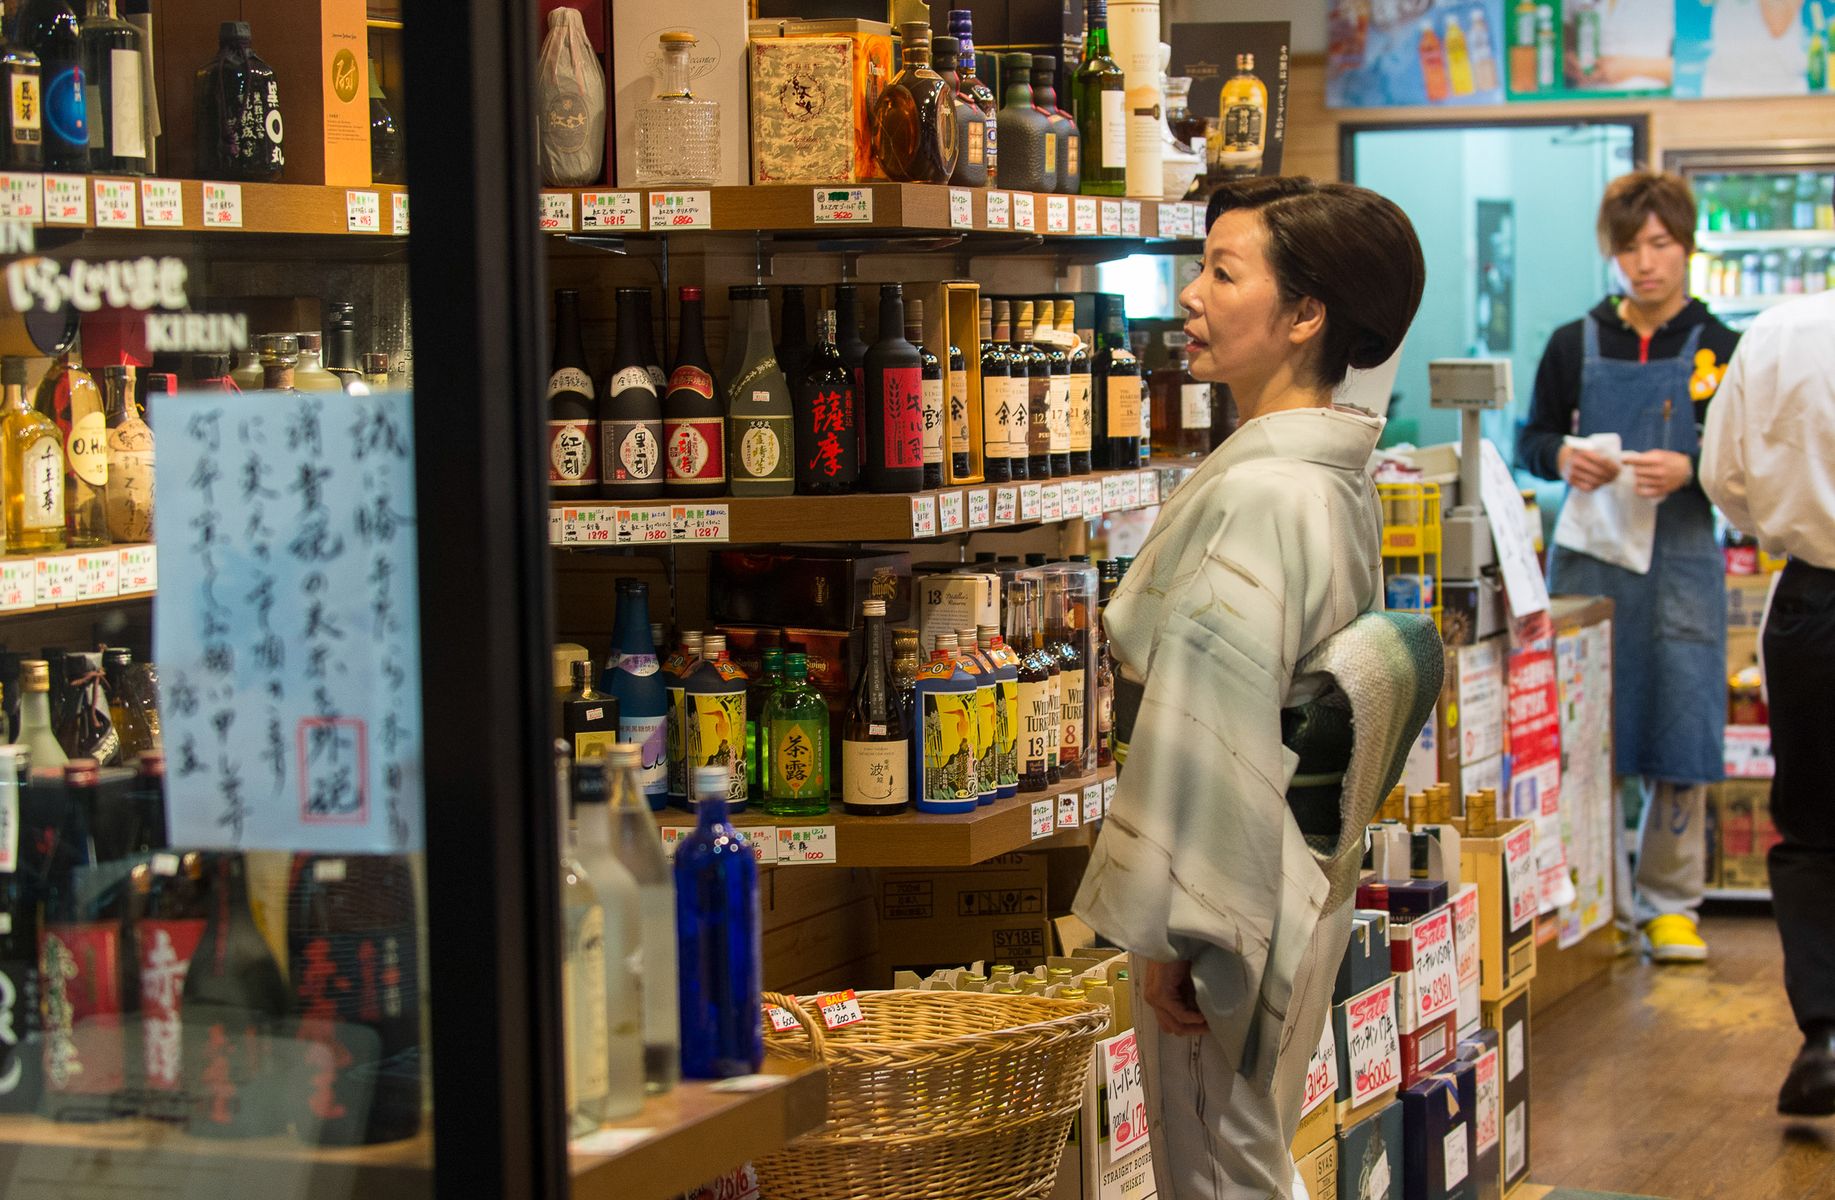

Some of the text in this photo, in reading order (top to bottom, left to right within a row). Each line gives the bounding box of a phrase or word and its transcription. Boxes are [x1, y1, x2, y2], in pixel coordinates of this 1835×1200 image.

[540, 219, 558, 227] 050
[604, 216, 625, 224] 4815
[0, 222, 34, 252] IN
[145, 313, 248, 350] KIRIN
[995, 400, 1010, 426] 余
[1012, 402, 1027, 427] 余
[1052, 409, 1063, 419] 17
[810, 392, 846, 477] 薩摩
[561, 434, 581, 476] 紅一刻
[644, 530, 667, 540] 1380
[694, 527, 719, 538] 1287
[928, 590, 941, 604] 13
[1065, 724, 1075, 744] 8
[784, 735, 808, 781] 茶露
[1028, 736, 1044, 757] 13
[793, 831, 811, 841] 焼酎
[805, 851, 824, 861] 1000
[1415, 920, 1447, 951] Sale
[825, 992, 848, 1005] SALE
[1433, 973, 1452, 1007] 8381
[835, 1014, 849, 1024] 200
[1352, 989, 1389, 1029] Sale
[783, 1017, 795, 1027] 600
[1306, 1062, 1329, 1101] 3143
[1368, 1058, 1391, 1091] 6000
[1103, 1160, 1133, 1186] STRAIGHT
[1120, 1171, 1146, 1195] WHISKEY
